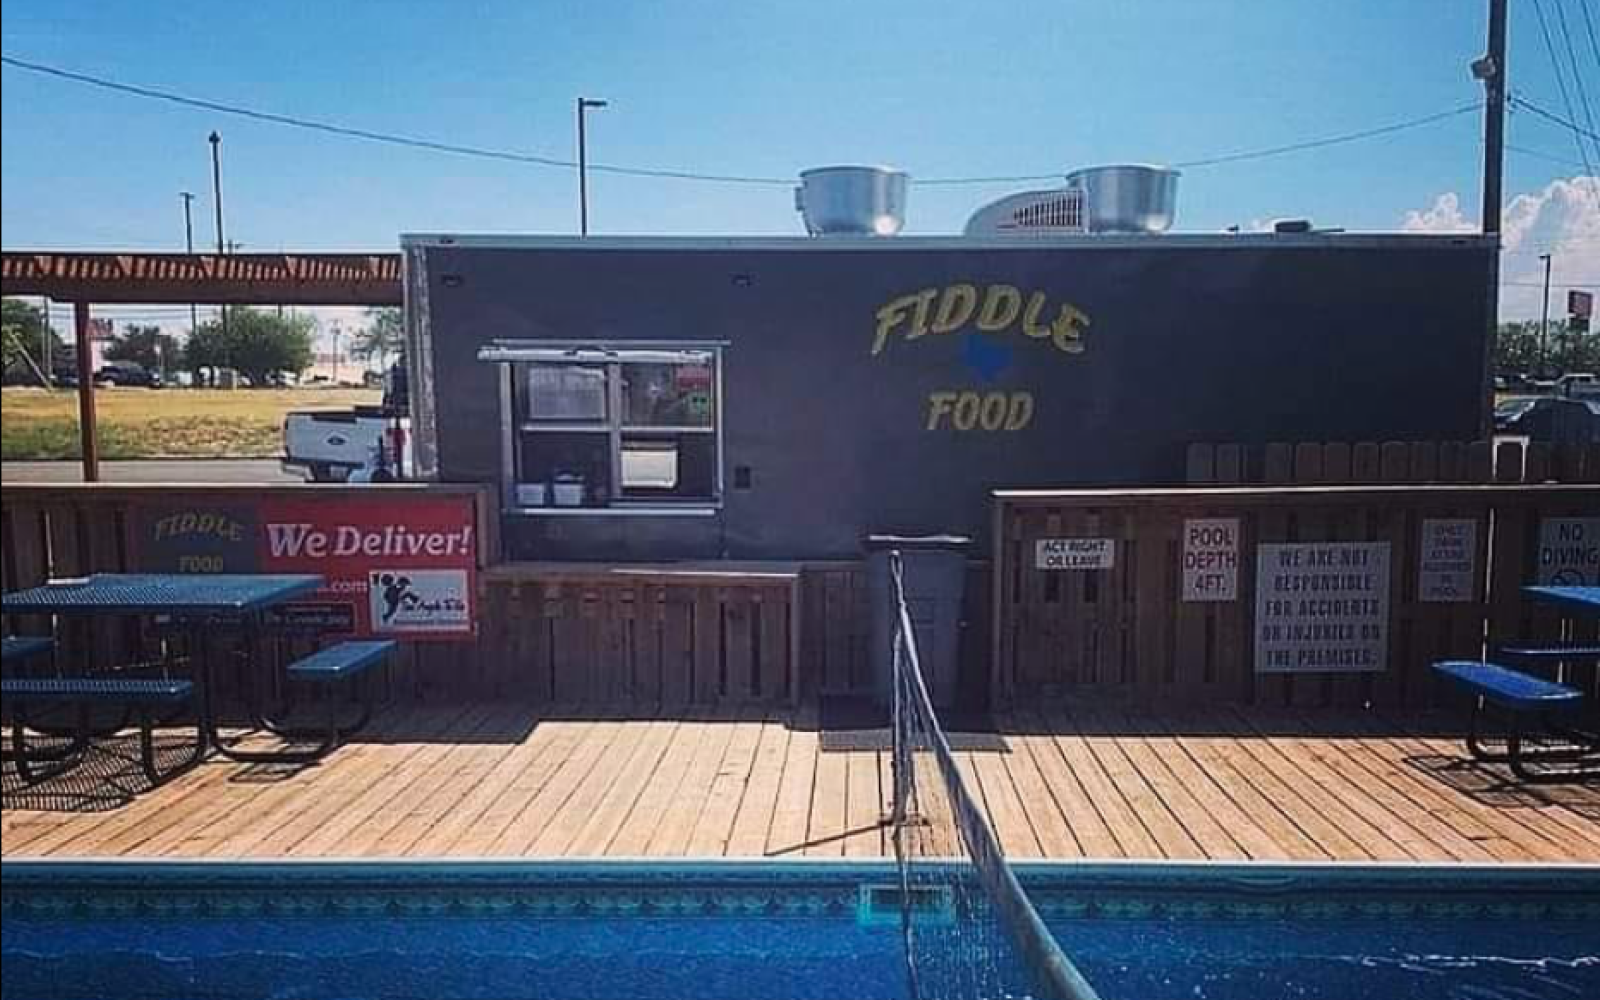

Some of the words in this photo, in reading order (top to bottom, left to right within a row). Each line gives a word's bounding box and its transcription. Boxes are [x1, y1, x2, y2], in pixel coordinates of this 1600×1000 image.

[871, 283, 1091, 355] FIDDLE
[926, 391, 1035, 431] FOOD
[154, 512, 244, 542] FIDDLE
[1190, 527, 1234, 546] POOL
[1559, 523, 1584, 541] NO
[266, 523, 327, 558] We
[334, 525, 472, 556] Deliver!
[178, 555, 224, 573] FOOD
[1185, 551, 1237, 570] DEPTH
[1279, 549, 1302, 567] WE
[1542, 547, 1599, 567] DIVING
[1274, 574, 1377, 592] RESPONSIBLE
[1265, 600, 1292, 617] FOR
